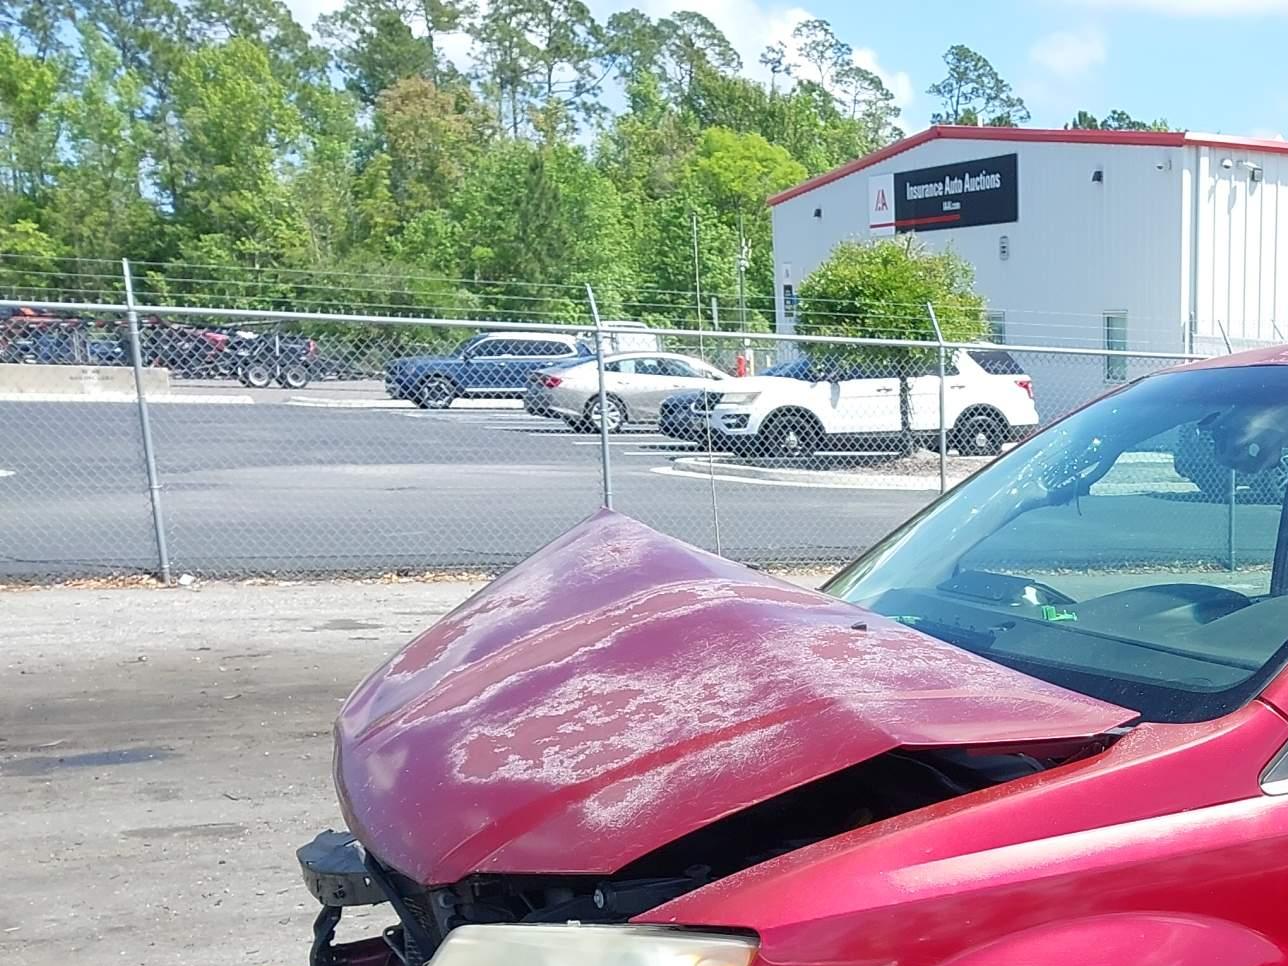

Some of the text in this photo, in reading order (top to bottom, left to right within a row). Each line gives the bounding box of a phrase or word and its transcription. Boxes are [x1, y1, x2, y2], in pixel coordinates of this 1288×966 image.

[906, 169, 1001, 201] Insurance Auto Auctions
